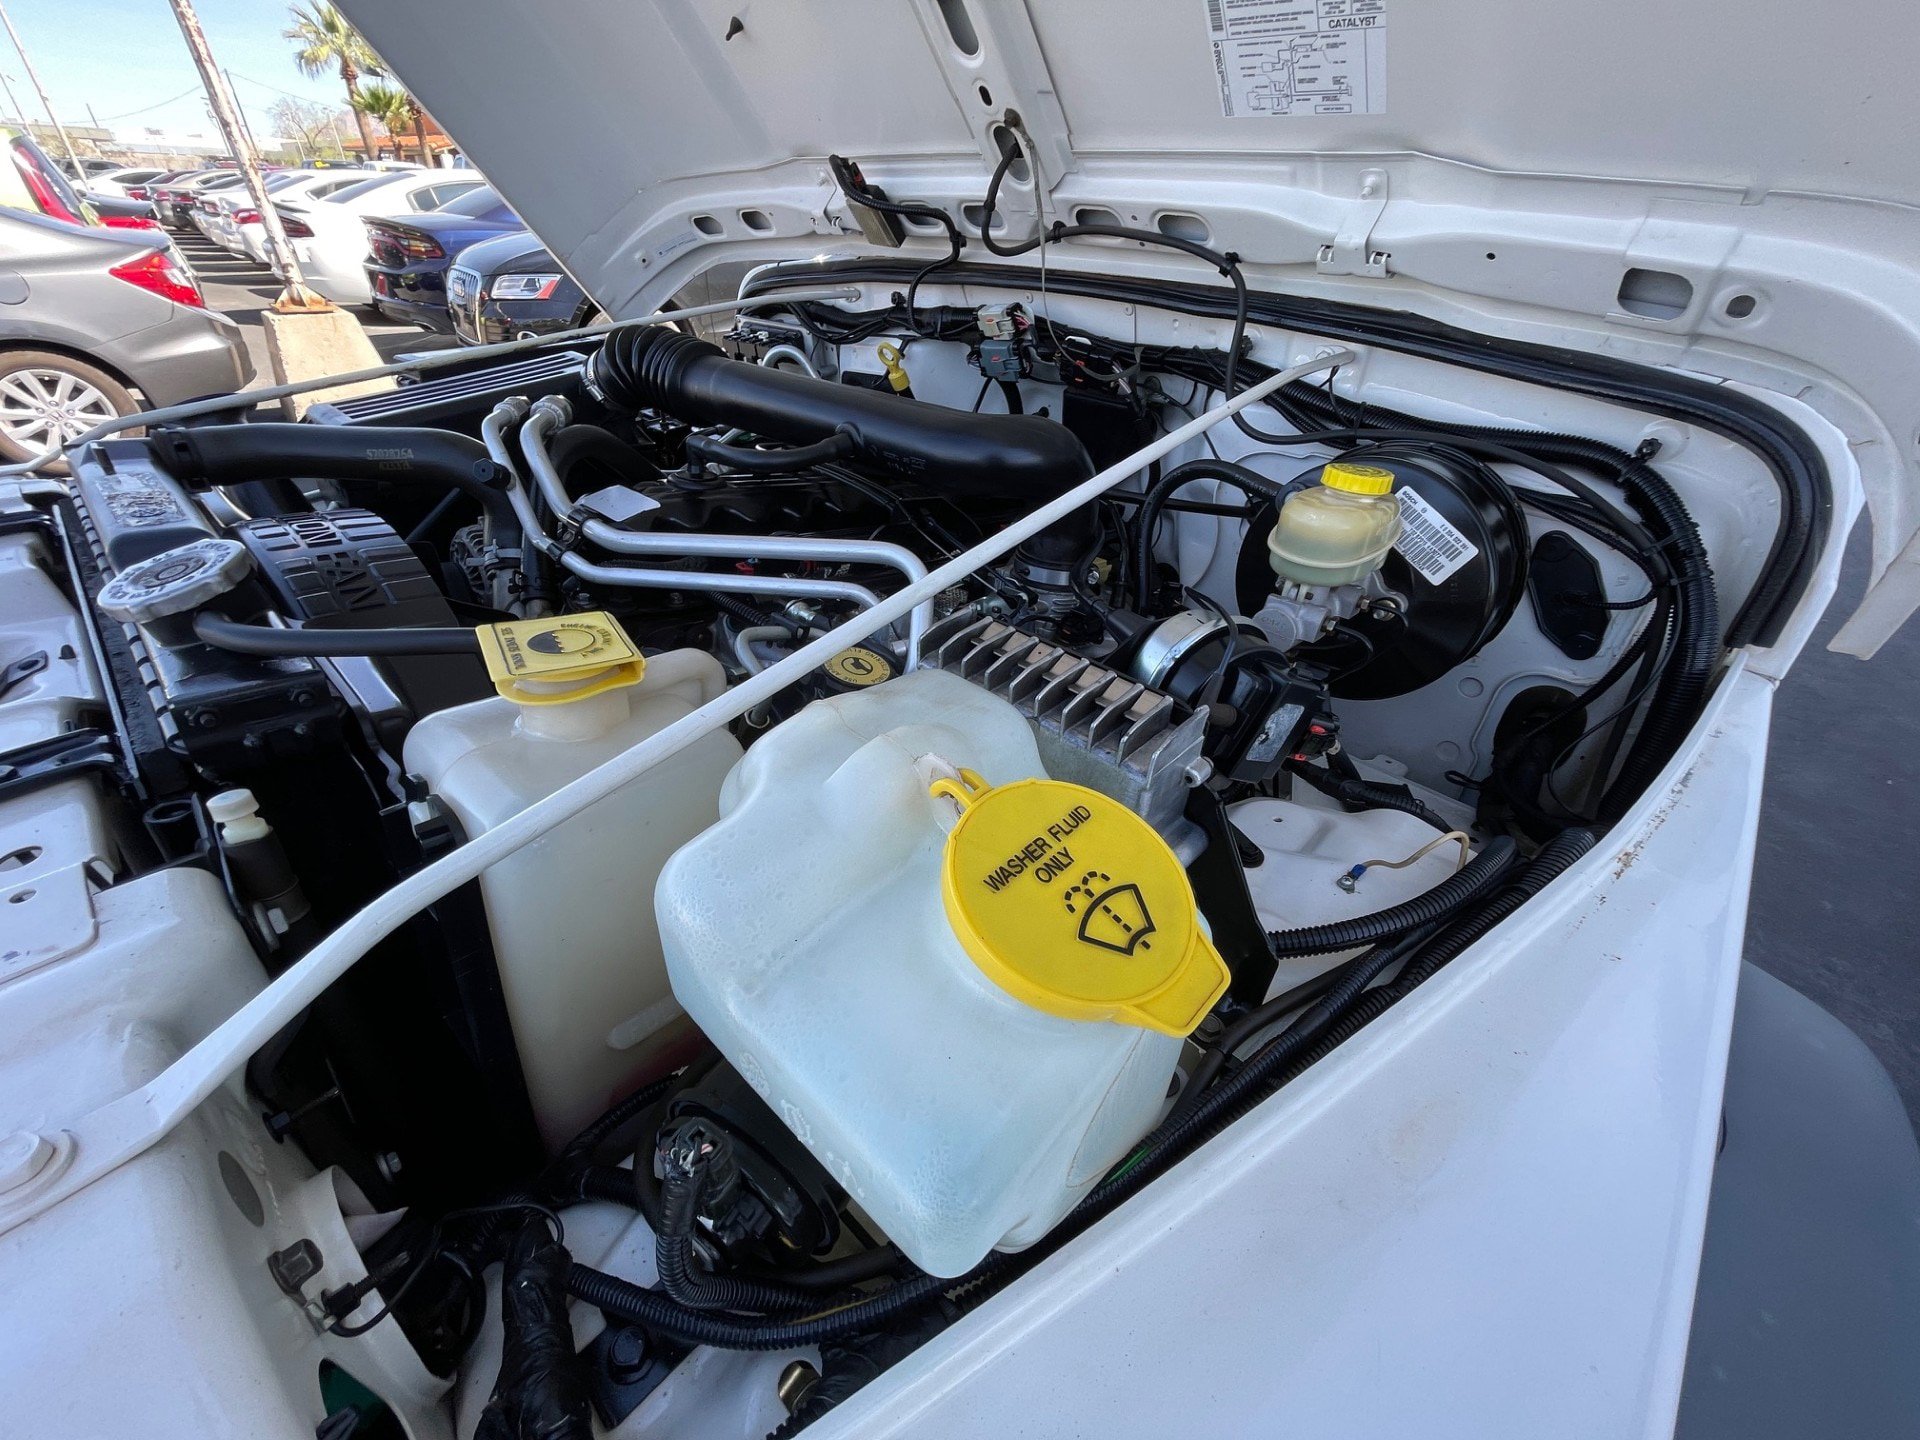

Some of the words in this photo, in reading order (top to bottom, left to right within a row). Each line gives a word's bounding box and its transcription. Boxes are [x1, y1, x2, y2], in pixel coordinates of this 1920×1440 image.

[1328, 16, 1378, 29] CATALYST
[1402, 490, 1418, 505] BOSCH
[983, 836, 1053, 892] WASHER
[1047, 805, 1092, 843] FLUID
[1034, 846, 1075, 884] ONLY
